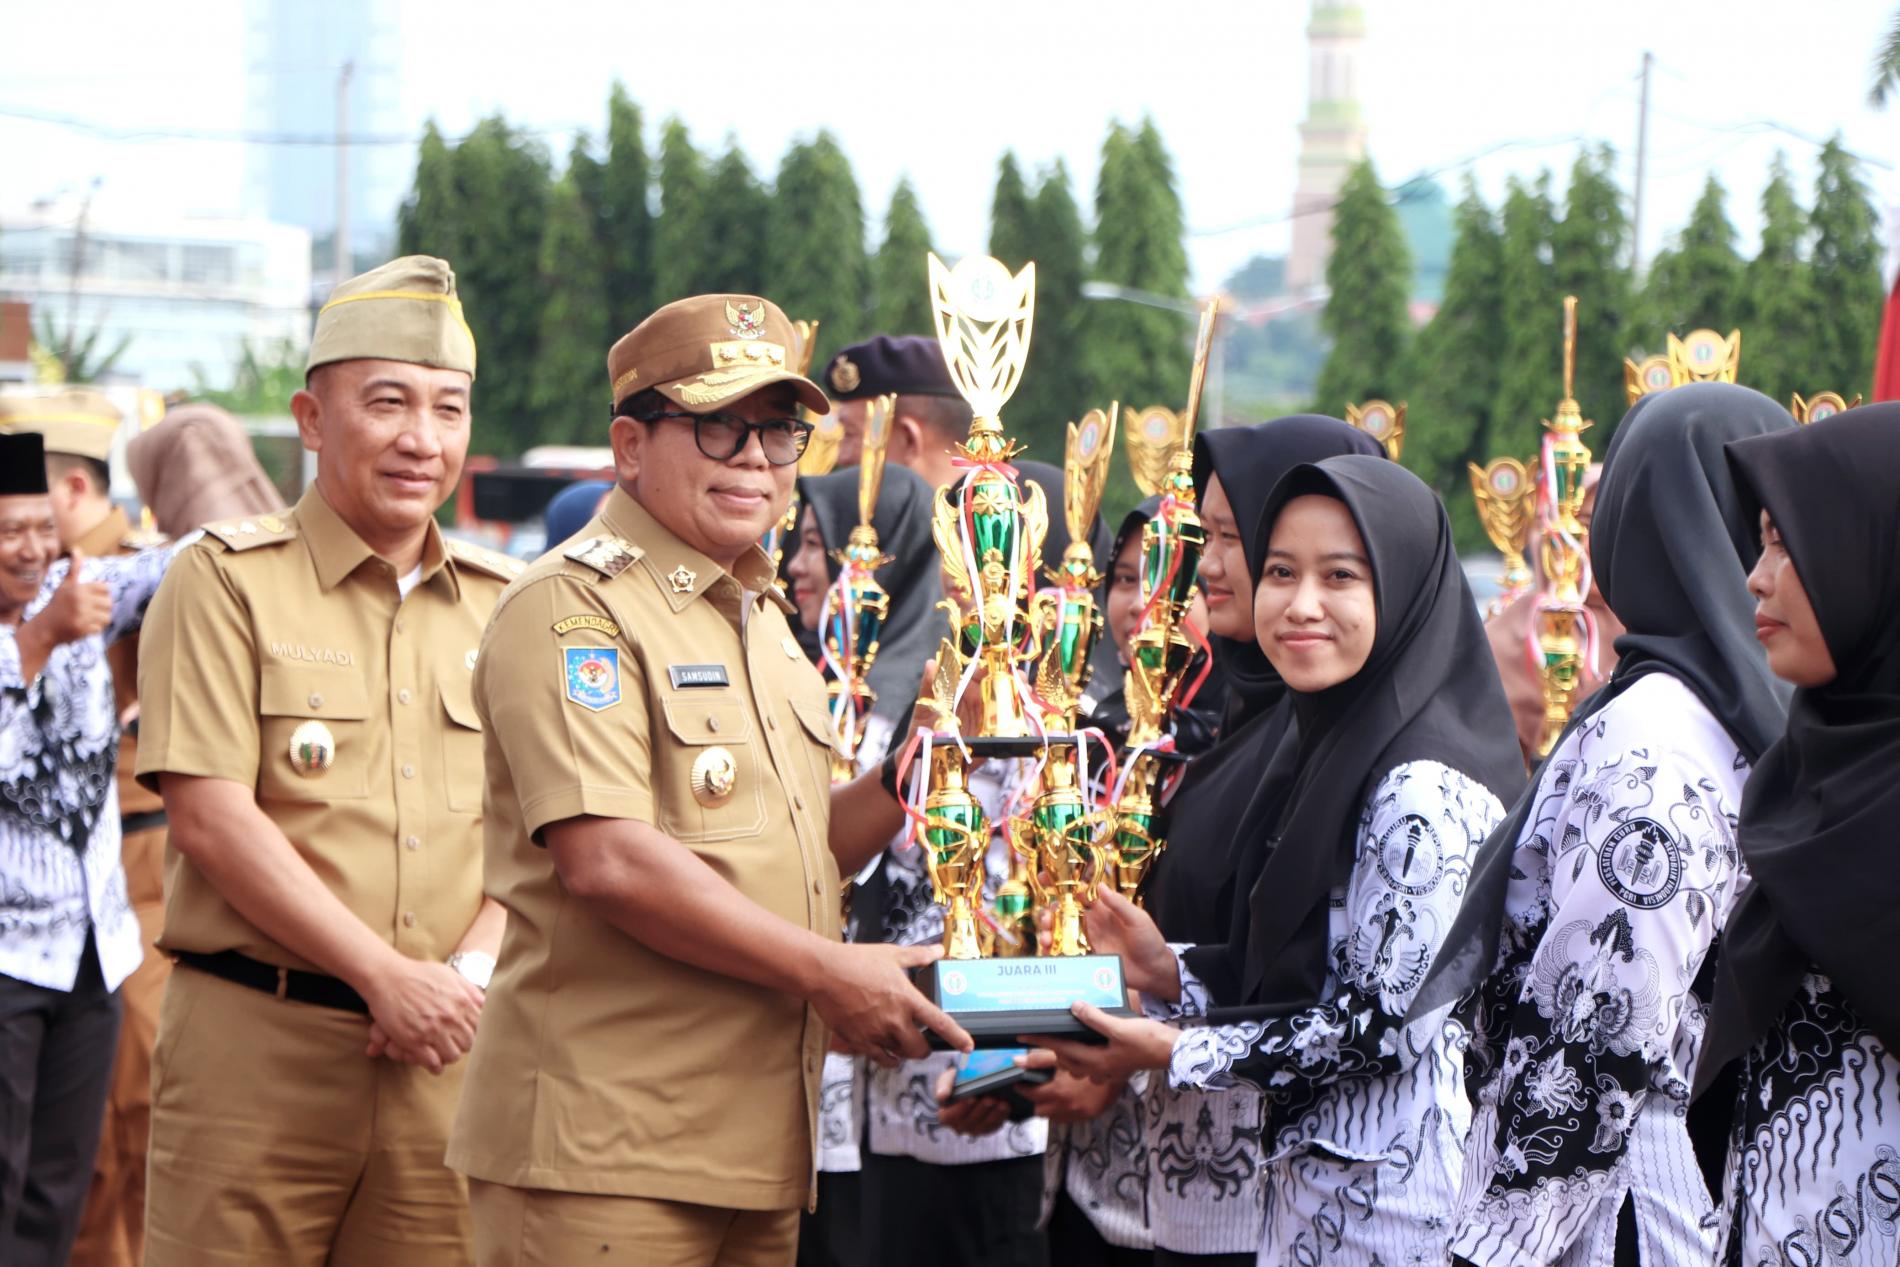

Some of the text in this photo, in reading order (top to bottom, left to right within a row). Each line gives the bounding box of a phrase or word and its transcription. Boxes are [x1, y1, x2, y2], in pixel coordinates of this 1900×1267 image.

[556, 616, 619, 634] KEMENDAGRI
[270, 643, 353, 666] MULYADI
[681, 671, 721, 681] SAMSUDIN
[1602, 823, 1678, 905] PERSATUAN GURU REPUBLIK INDONESIA
[1619, 888, 1637, 903] PGRI
[998, 964, 1057, 976] JUARA III
